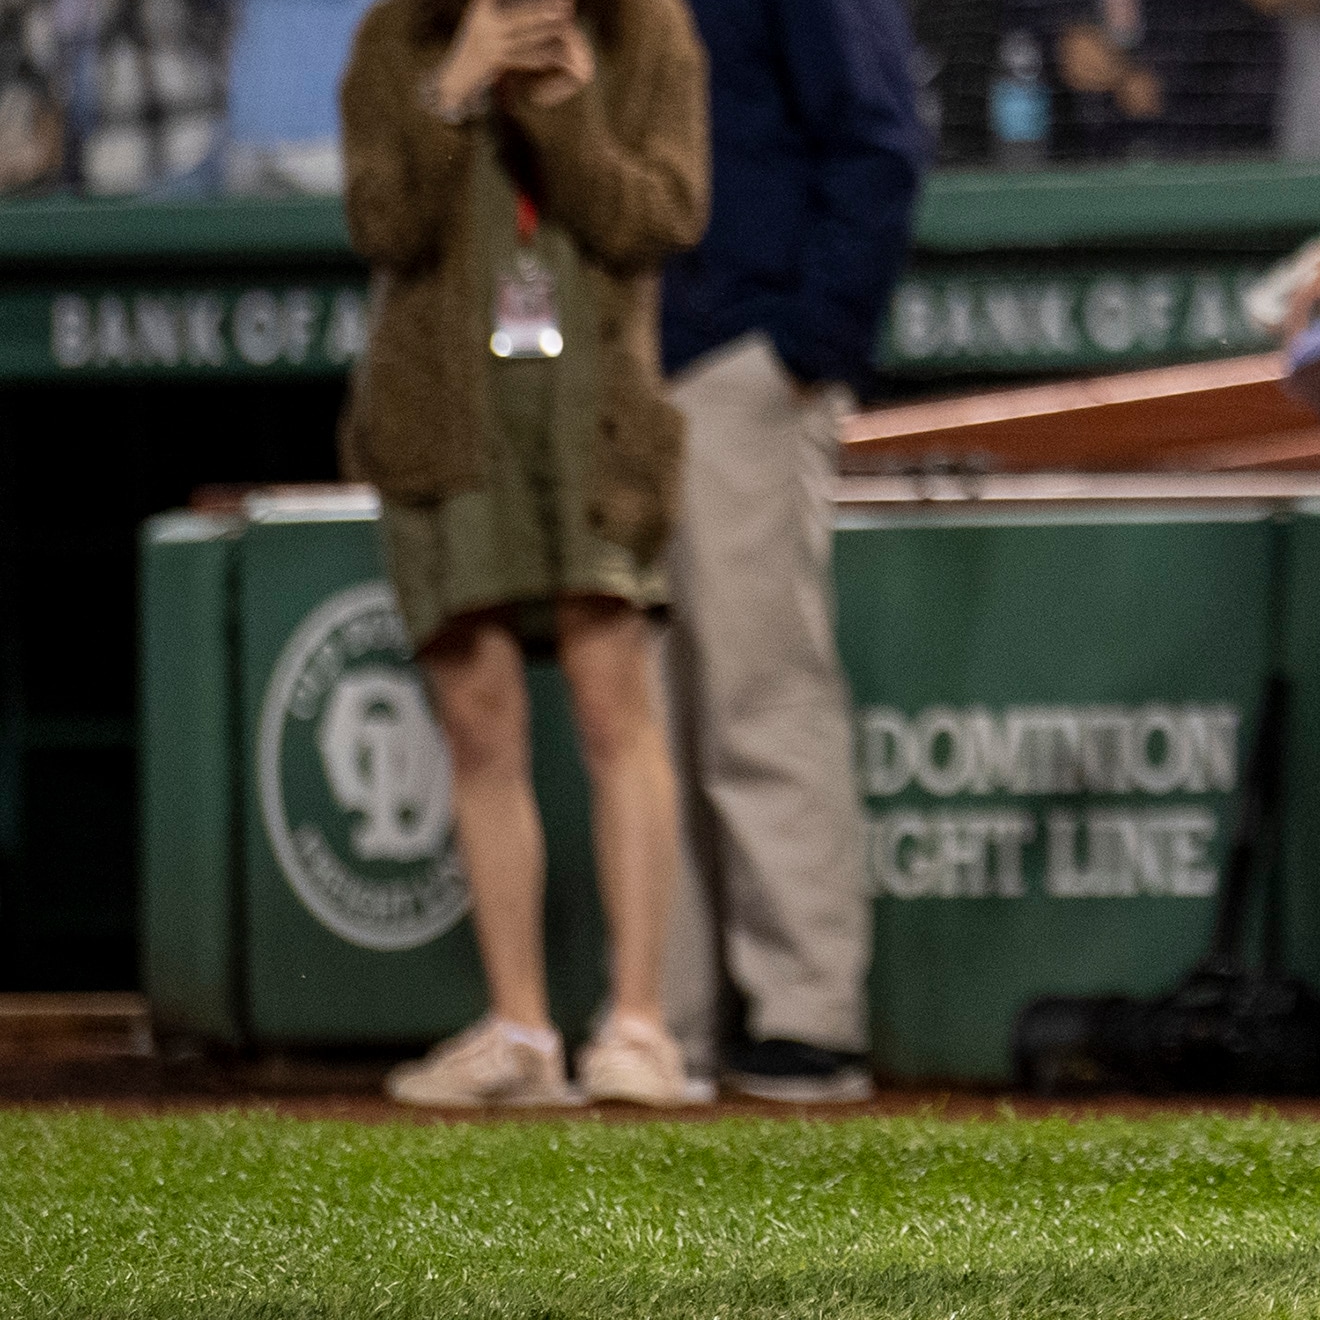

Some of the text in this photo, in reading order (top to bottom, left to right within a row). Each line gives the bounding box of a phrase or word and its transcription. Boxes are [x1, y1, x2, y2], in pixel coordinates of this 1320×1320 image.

[53, 291, 226, 369] BANK
[233, 286, 314, 367] OF
[864, 705, 1239, 796] DOMINION
[1046, 808, 1219, 898] LINE
